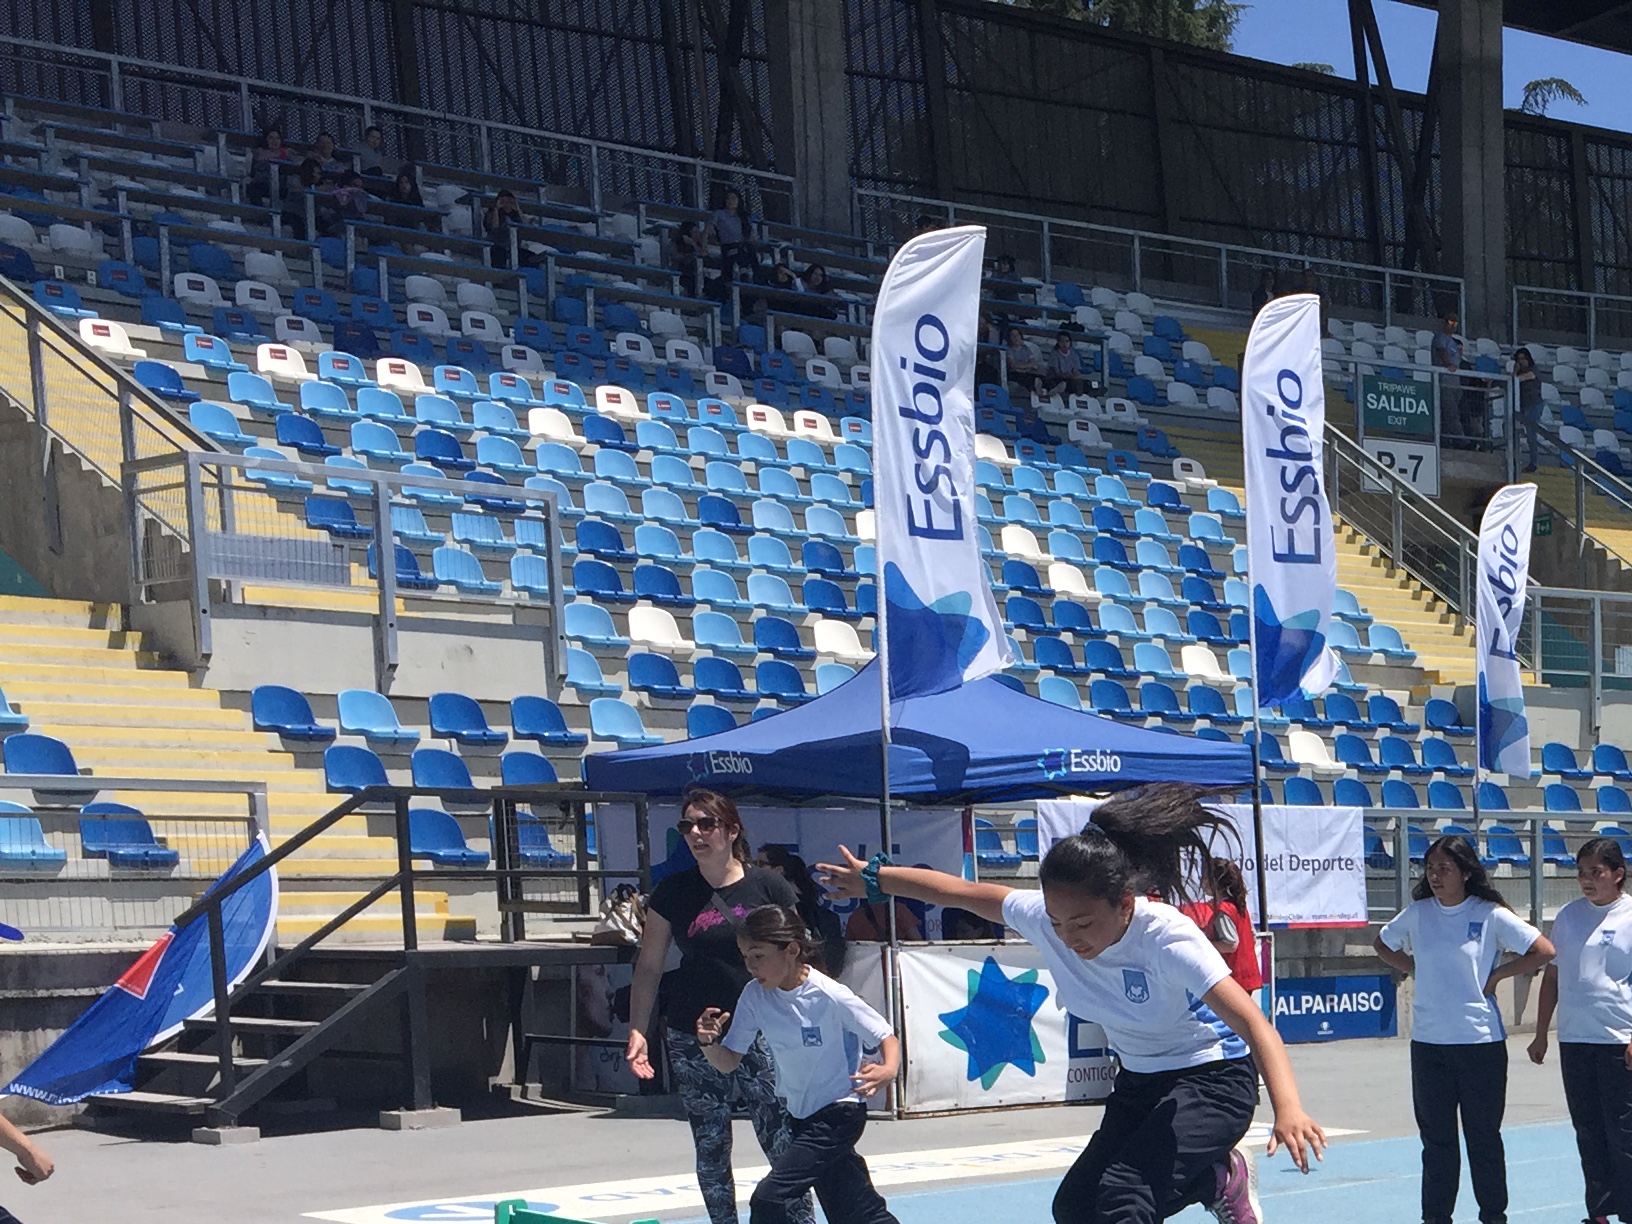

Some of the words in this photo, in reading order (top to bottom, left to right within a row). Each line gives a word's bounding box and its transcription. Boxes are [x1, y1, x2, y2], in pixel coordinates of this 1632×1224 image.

[1377, 382, 1416, 395] TRIPAWE
[1366, 393, 1430, 416] SALIDA
[899, 314, 964, 541] Essbio
[1387, 415, 1408, 426] EXIT
[1256, 369, 1322, 565] Essbio
[1377, 450, 1424, 483] P-7
[709, 750, 753, 774] Essbio
[1070, 748, 1122, 773] Essbio
[1289, 854, 1355, 876] Deporte
[1275, 991, 1385, 1016] ALPARAISO
[1067, 1065, 1117, 1084] CONTIGO
